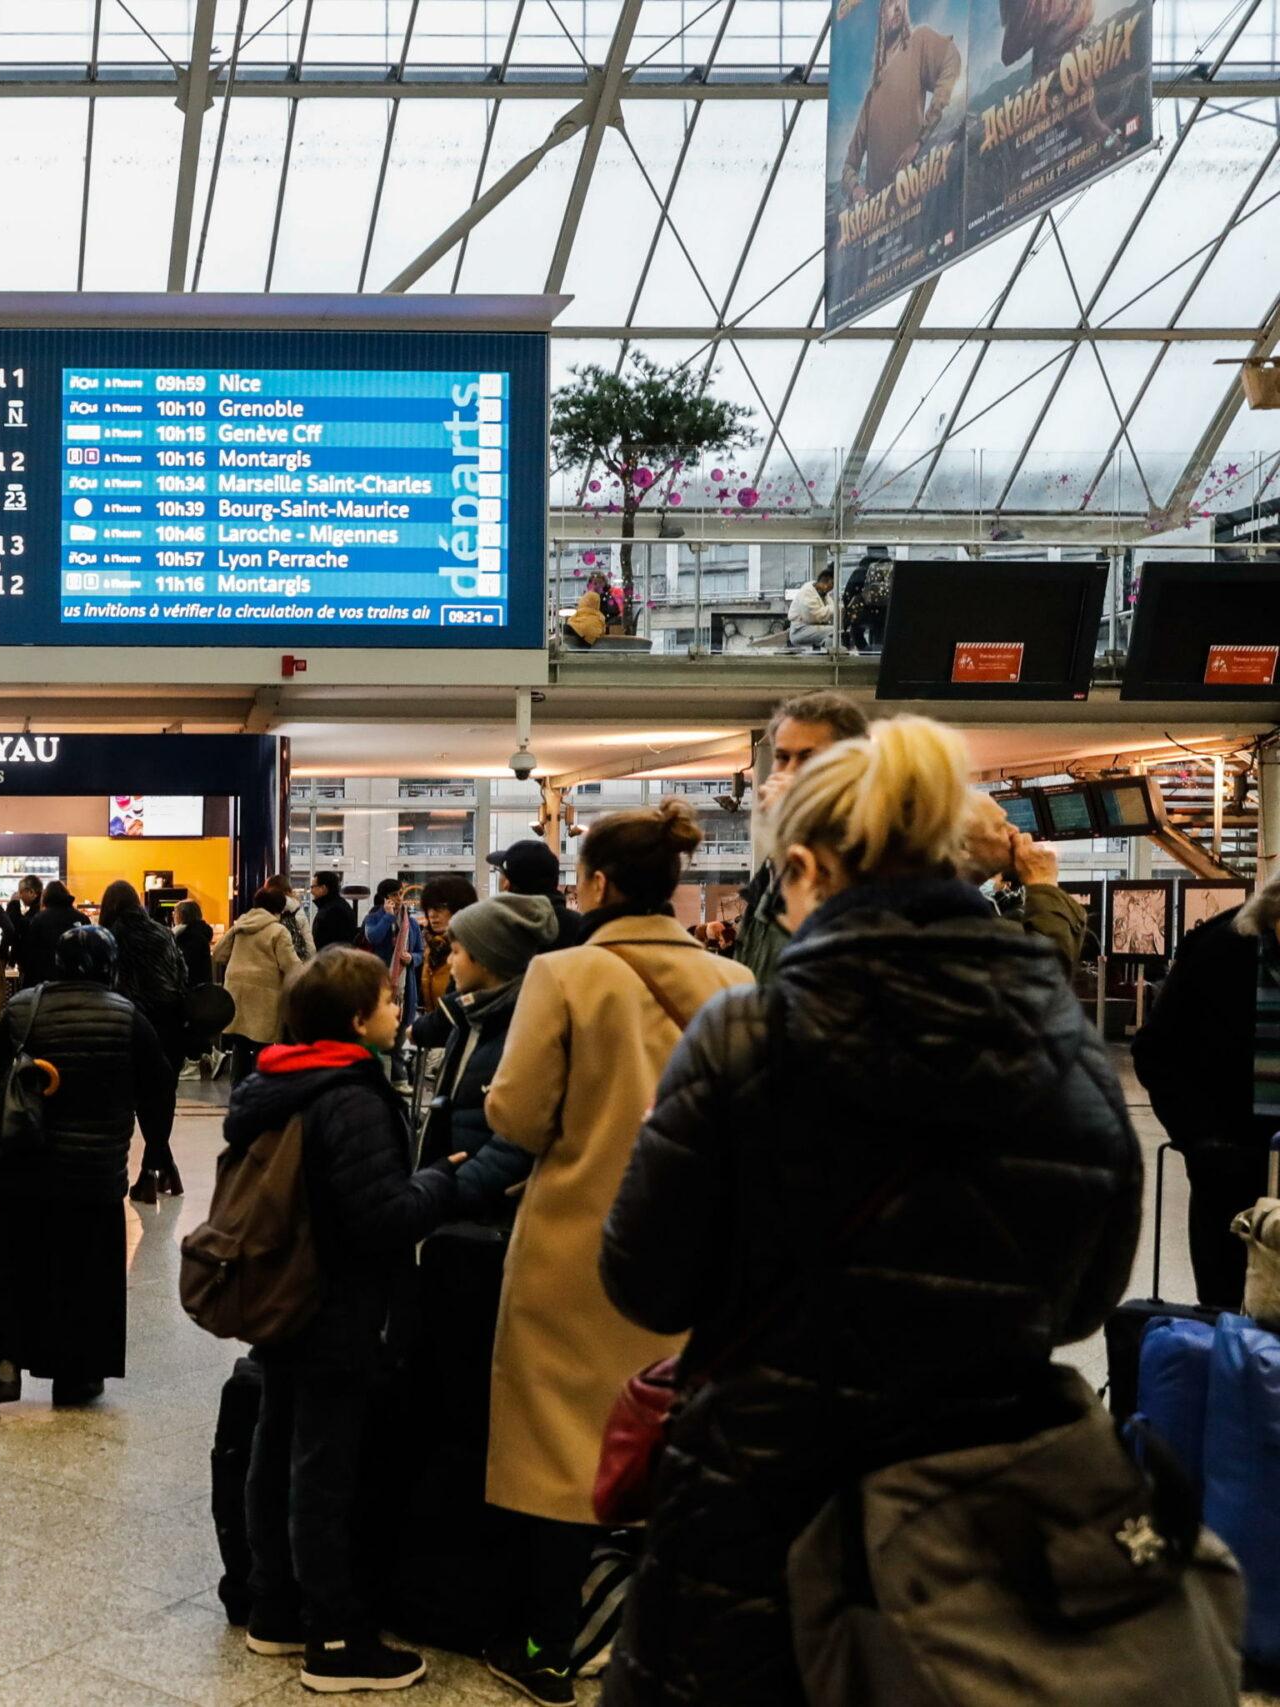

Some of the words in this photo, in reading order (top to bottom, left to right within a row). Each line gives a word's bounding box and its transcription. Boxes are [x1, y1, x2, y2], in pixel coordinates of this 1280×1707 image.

[1060, 11, 1142, 95] Obélix
[13, 369, 23, 387] 1
[156, 376, 205, 391] 09h59
[220, 374, 261, 392] Nice
[9, 408, 24, 423] N
[157, 401, 205, 416] 10h10
[219, 400, 303, 417] Grenoble
[156, 426, 205, 441] 10h15
[219, 424, 288, 442] Genève
[293, 424, 322, 442] Cff
[12, 452, 24, 471] 2
[157, 452, 204, 466] 10h16
[220, 450, 311, 471] Montargis
[156, 476, 206, 492] 10h34
[219, 474, 302, 492] Marseille
[307, 475, 432, 492] Saint-Charles
[5, 492, 27, 507] 23
[157, 502, 204, 516] 10h39
[220, 500, 409, 521] Bourg-Saint-Maurice
[156, 526, 205, 542] 10h46
[219, 525, 292, 542] Laroche
[310, 525, 398, 547] Migennes
[11, 536, 24, 555] 3
[156, 552, 204, 566] 10h57
[219, 550, 261, 570] Lyon
[268, 550, 348, 567] Perrache
[10, 576, 23, 594] 2
[156, 576, 204, 592] 11h16
[218, 574, 310, 596] Montargis
[84, 603, 146, 617] invitions
[150, 604, 159, 617] à
[164, 604, 214, 617] vérifier
[218, 605, 231, 617] la
[236, 604, 313, 618] circulation
[318, 605, 335, 618] de
[340, 608, 363, 618] vos
[368, 606, 408, 618] trains
[449, 611, 481, 622] 09:21
